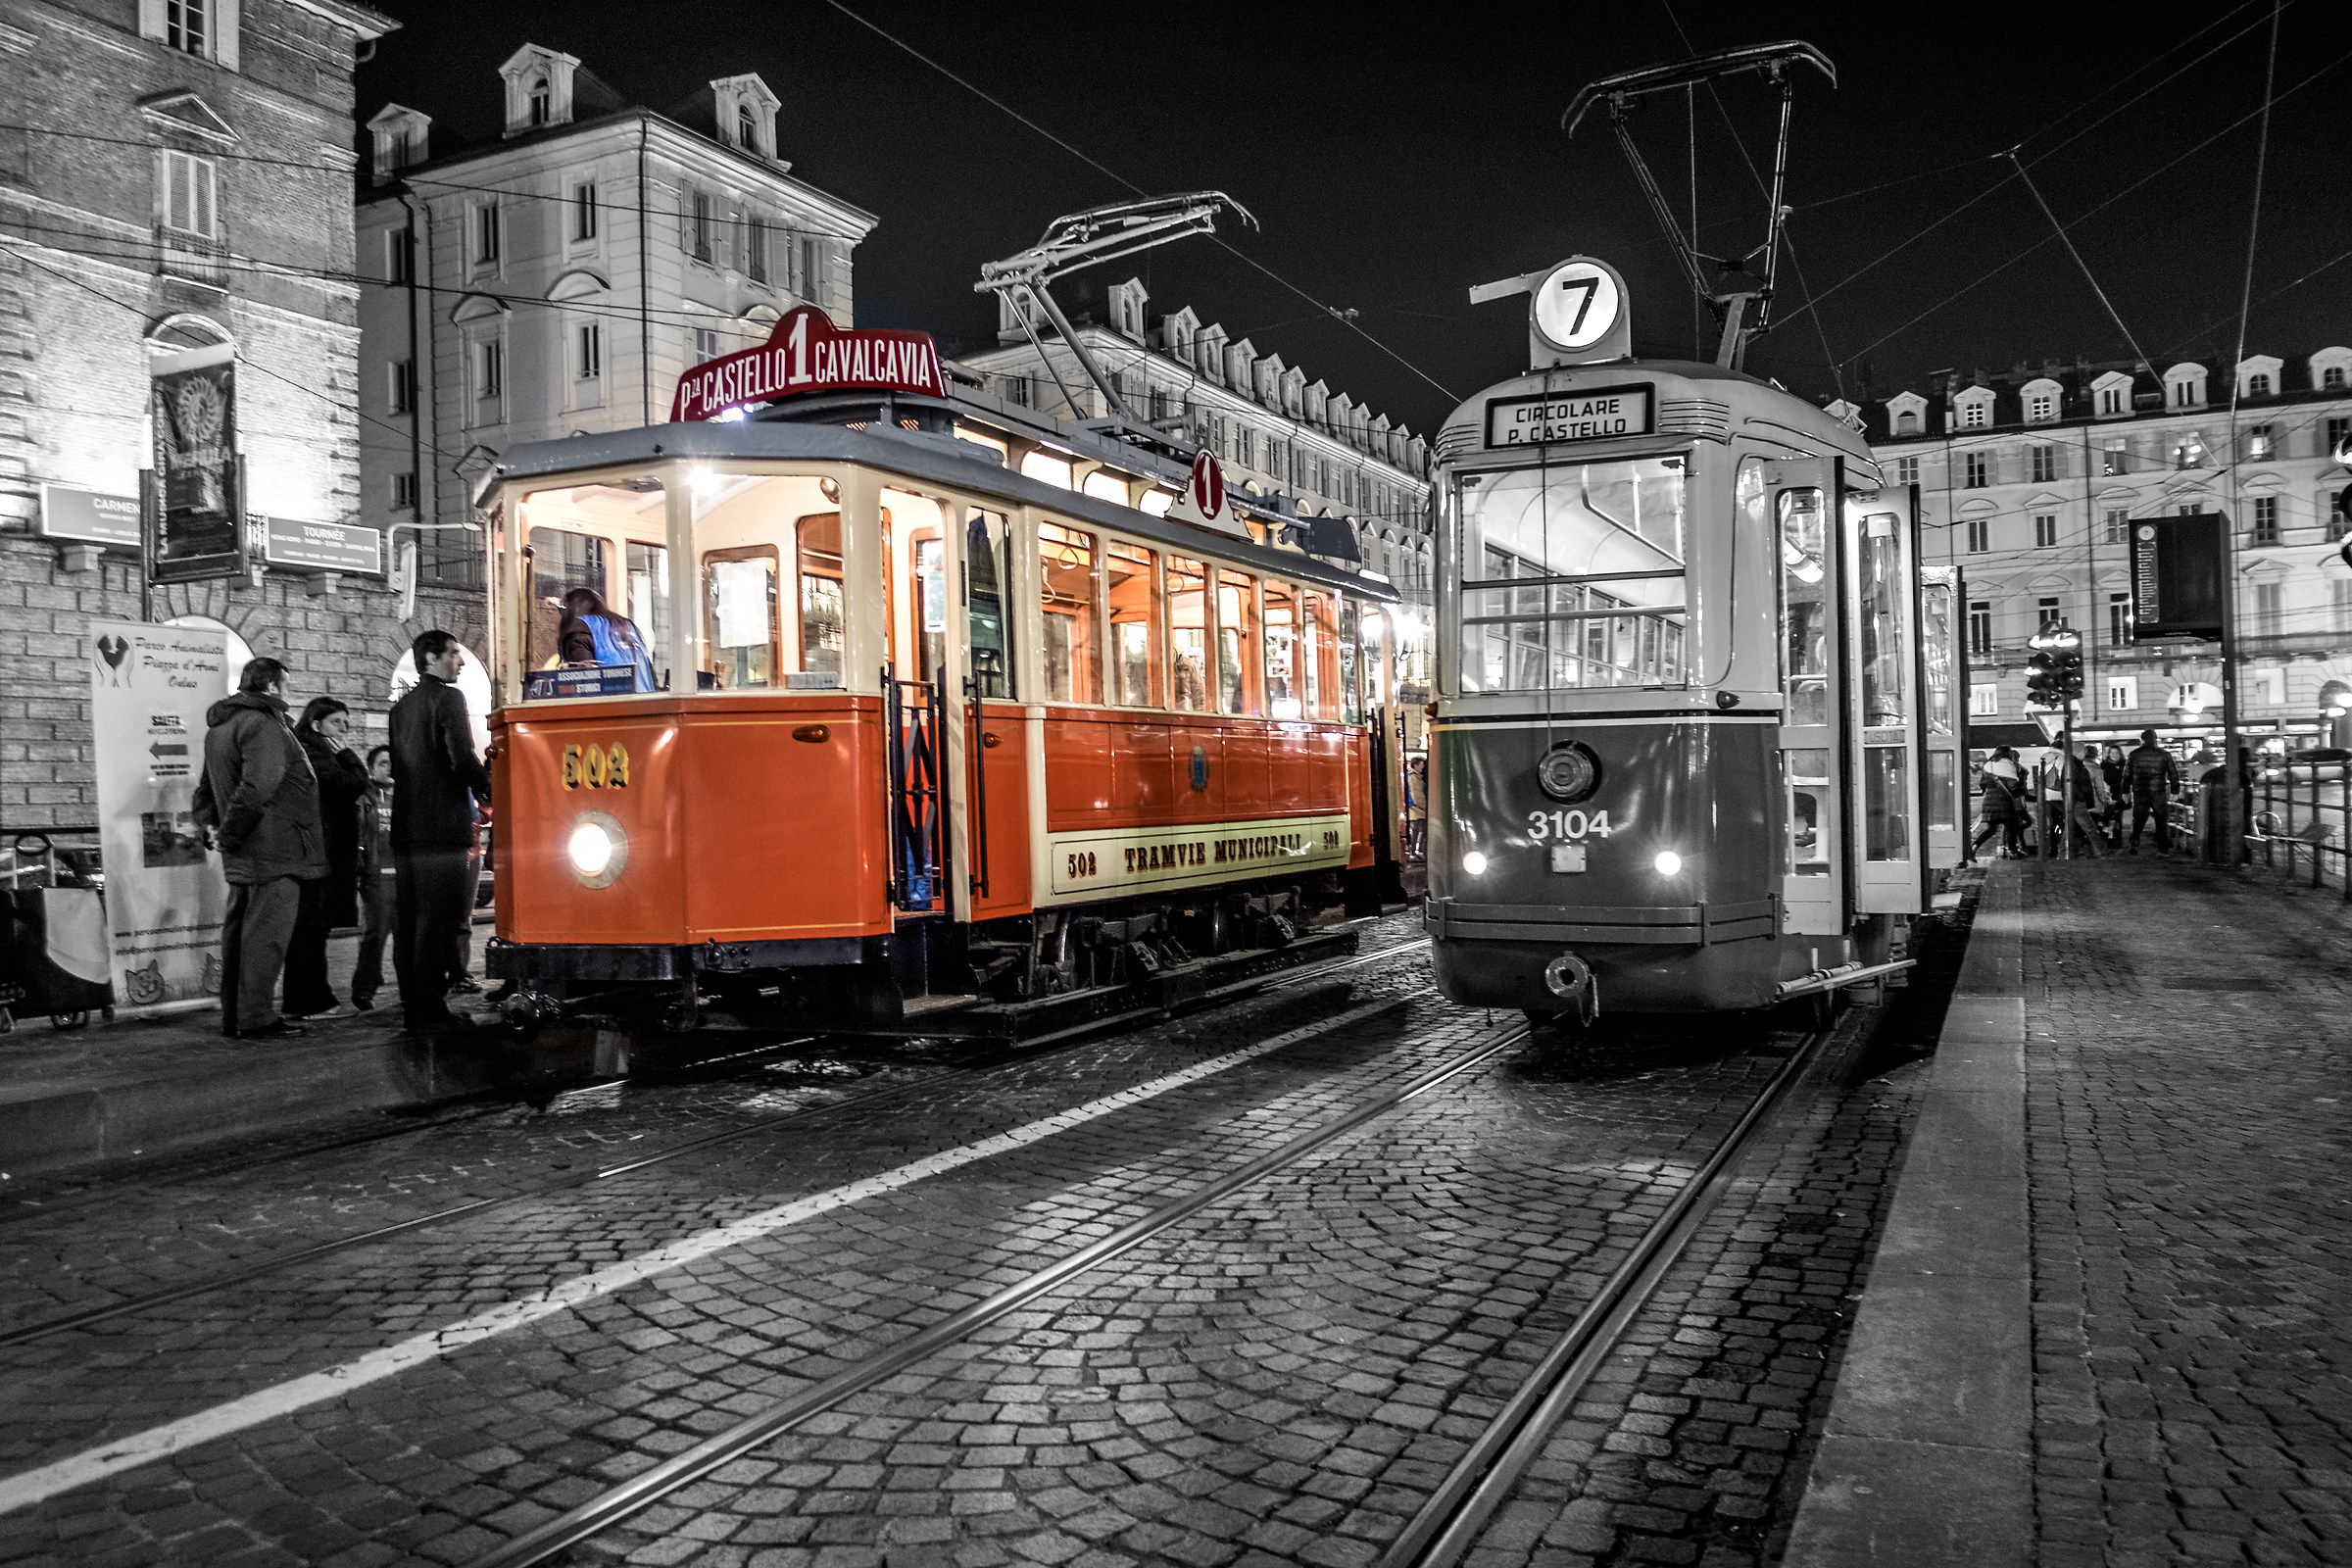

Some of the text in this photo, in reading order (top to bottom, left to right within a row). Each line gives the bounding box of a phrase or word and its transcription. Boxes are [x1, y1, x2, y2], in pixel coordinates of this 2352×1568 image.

[1562, 276, 1599, 336] 7
[703, 348, 786, 413] CASTELLO
[788, 313, 812, 385] 1
[814, 338, 932, 388] CAVALCAVIA
[1516, 399, 1620, 423] CIRCOLARE
[1508, 418, 1627, 444] P. CASTELLO
[1202, 457, 1215, 515] 1
[93, 497, 140, 514] CARMEN
[303, 525, 346, 541] TOURNÉE
[562, 741, 630, 791] 502
[1527, 809, 1612, 839] 3104
[1067, 852, 1098, 879] 502
[1124, 842, 1206, 872] TRAMVIE
[1213, 833, 1301, 862] MUNICIPALI
